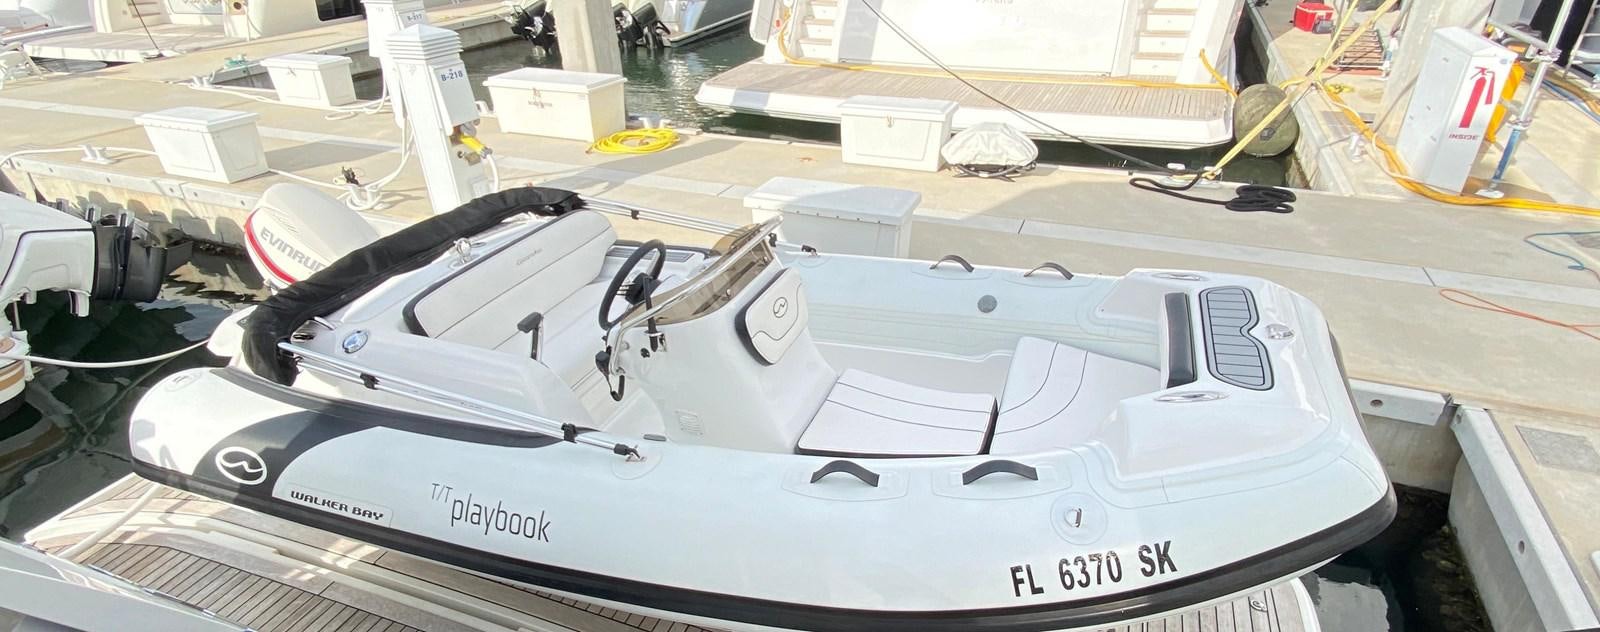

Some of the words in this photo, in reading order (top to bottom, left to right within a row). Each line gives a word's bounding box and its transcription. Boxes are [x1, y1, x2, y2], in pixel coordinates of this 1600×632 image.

[441, 70, 464, 81] B-218
[290, 490, 349, 513] WALKER
[352, 506, 384, 521] BAY
[431, 482, 454, 503] T/T
[451, 493, 551, 543] playbook
[1009, 563, 1045, 598] FL
[1058, 550, 1123, 591] 6370
[1138, 540, 1178, 578] SK
